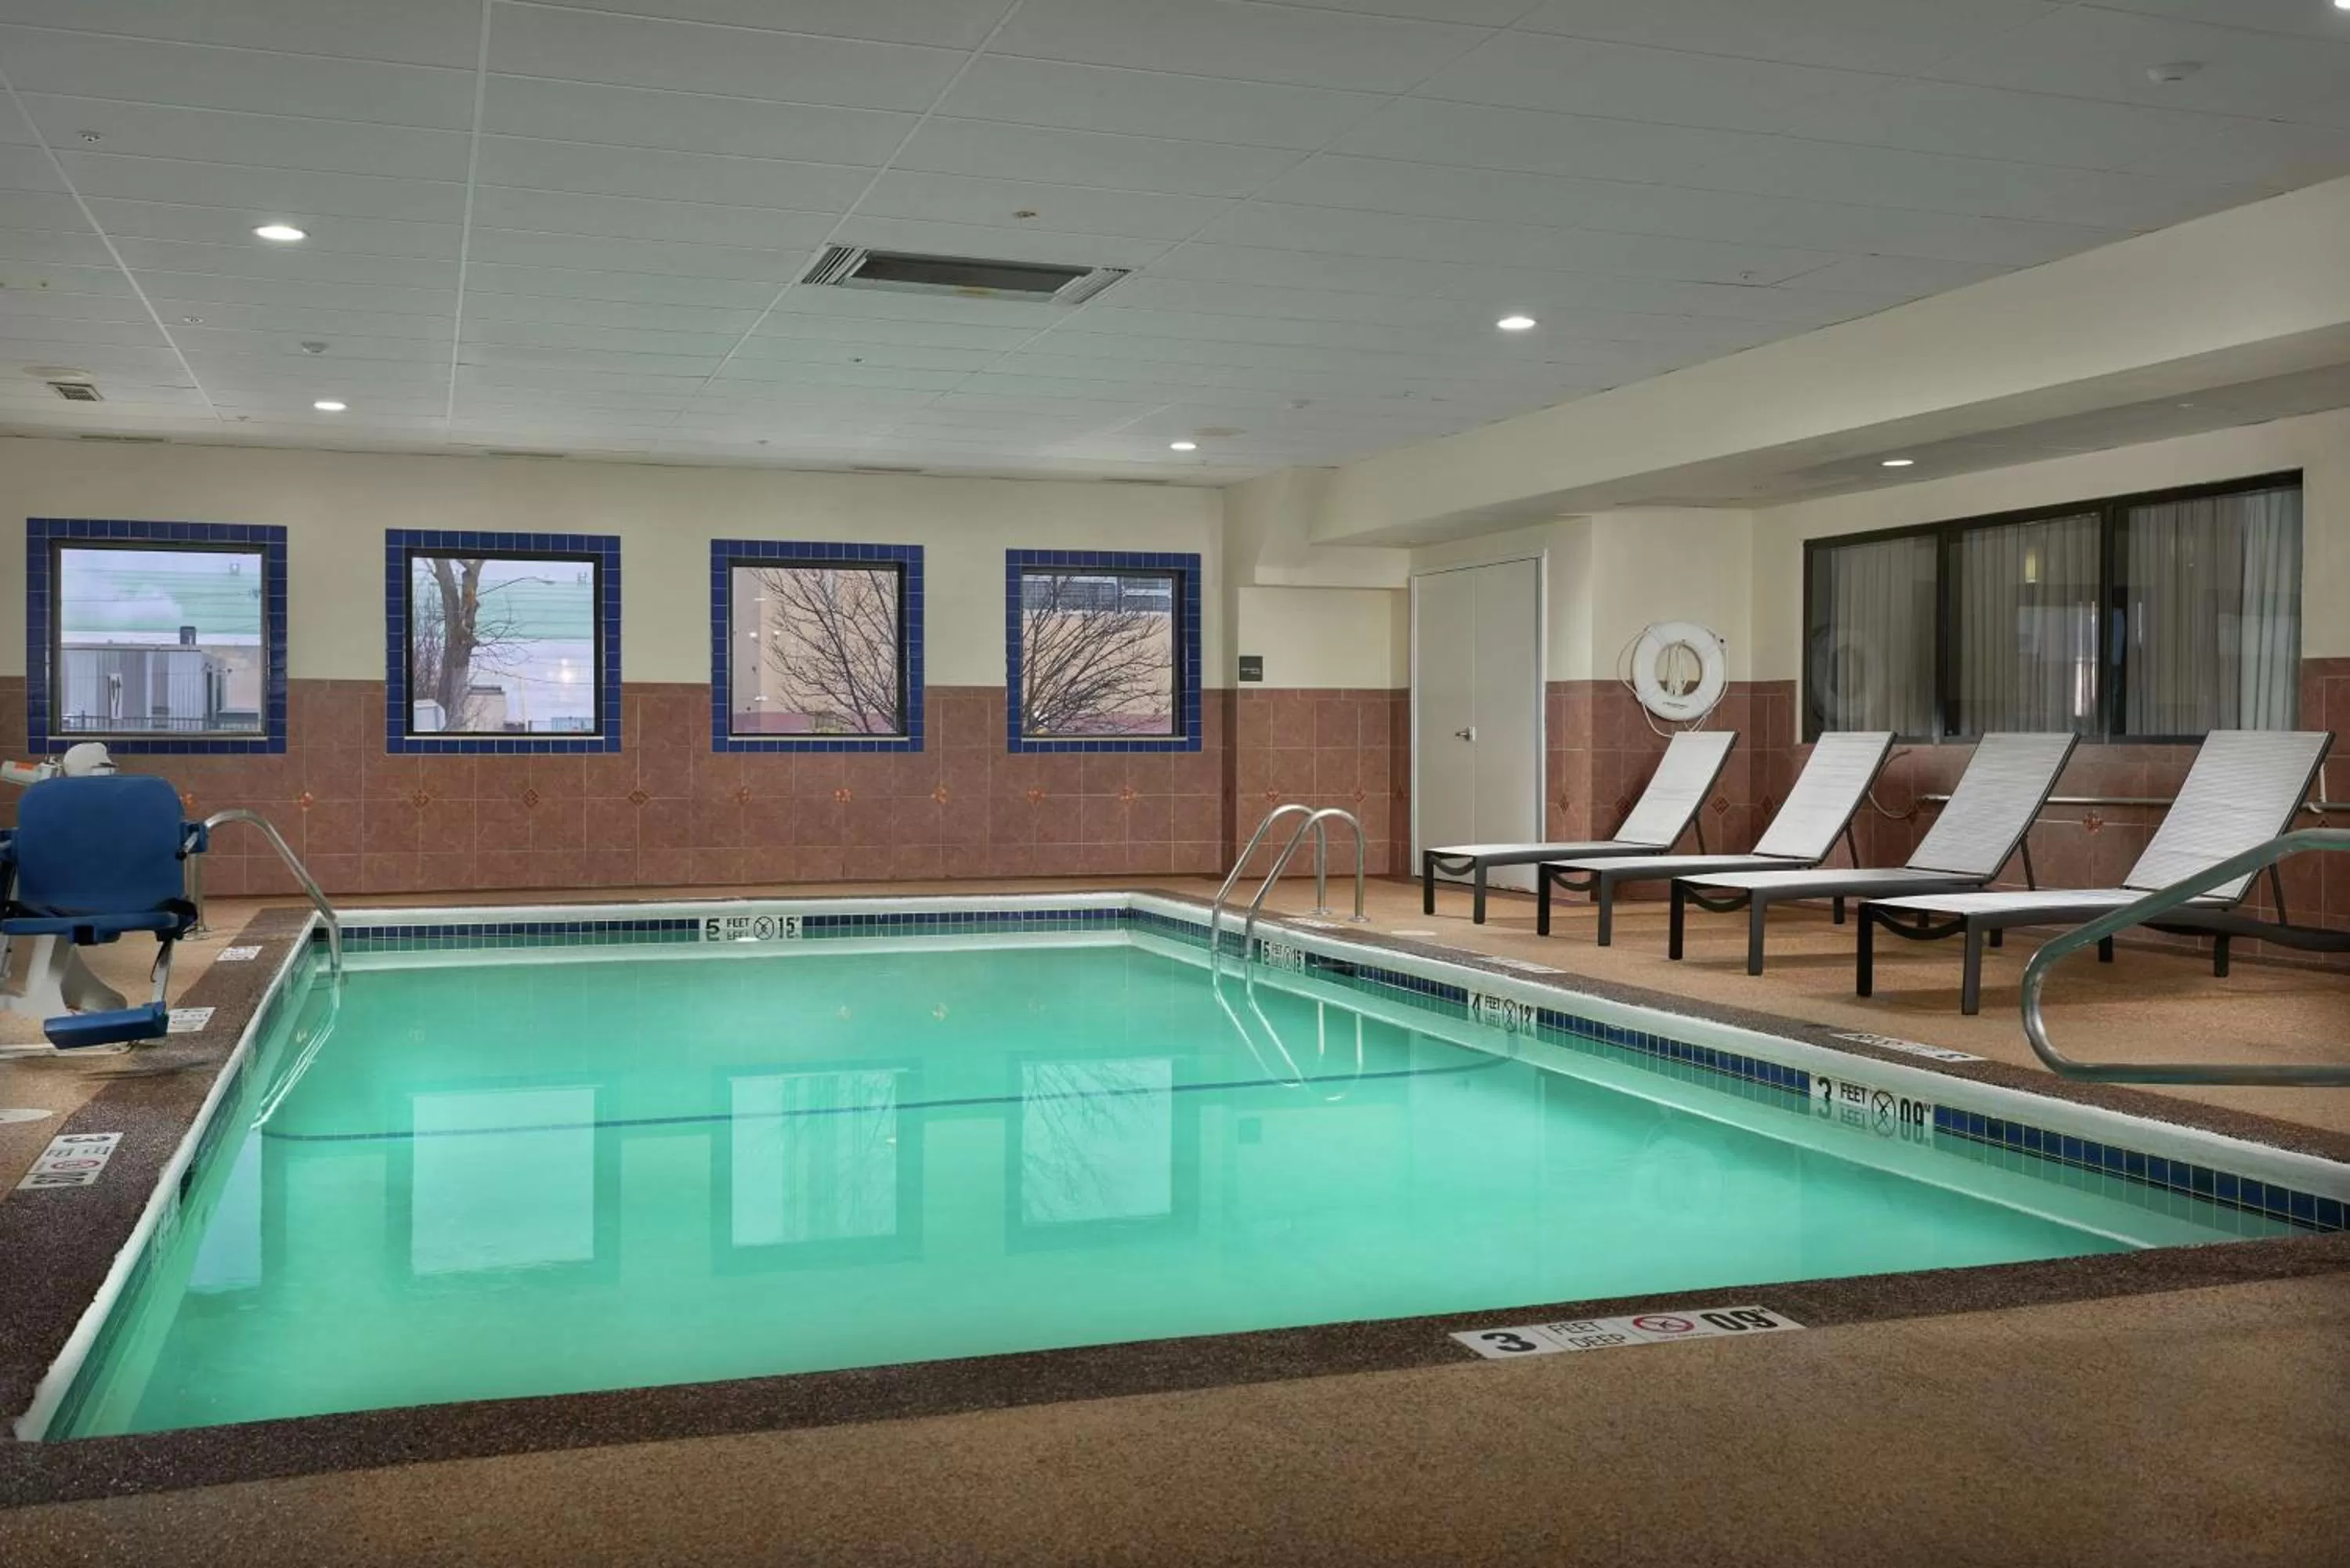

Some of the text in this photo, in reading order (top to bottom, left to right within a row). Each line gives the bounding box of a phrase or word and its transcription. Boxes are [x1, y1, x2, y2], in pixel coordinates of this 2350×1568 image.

[1841, 1082, 1868, 1105] FEET
[1480, 1332, 1537, 1352] 3
[1547, 1321, 1603, 1335] FEET
[1568, 1333, 1627, 1348] DEEP
